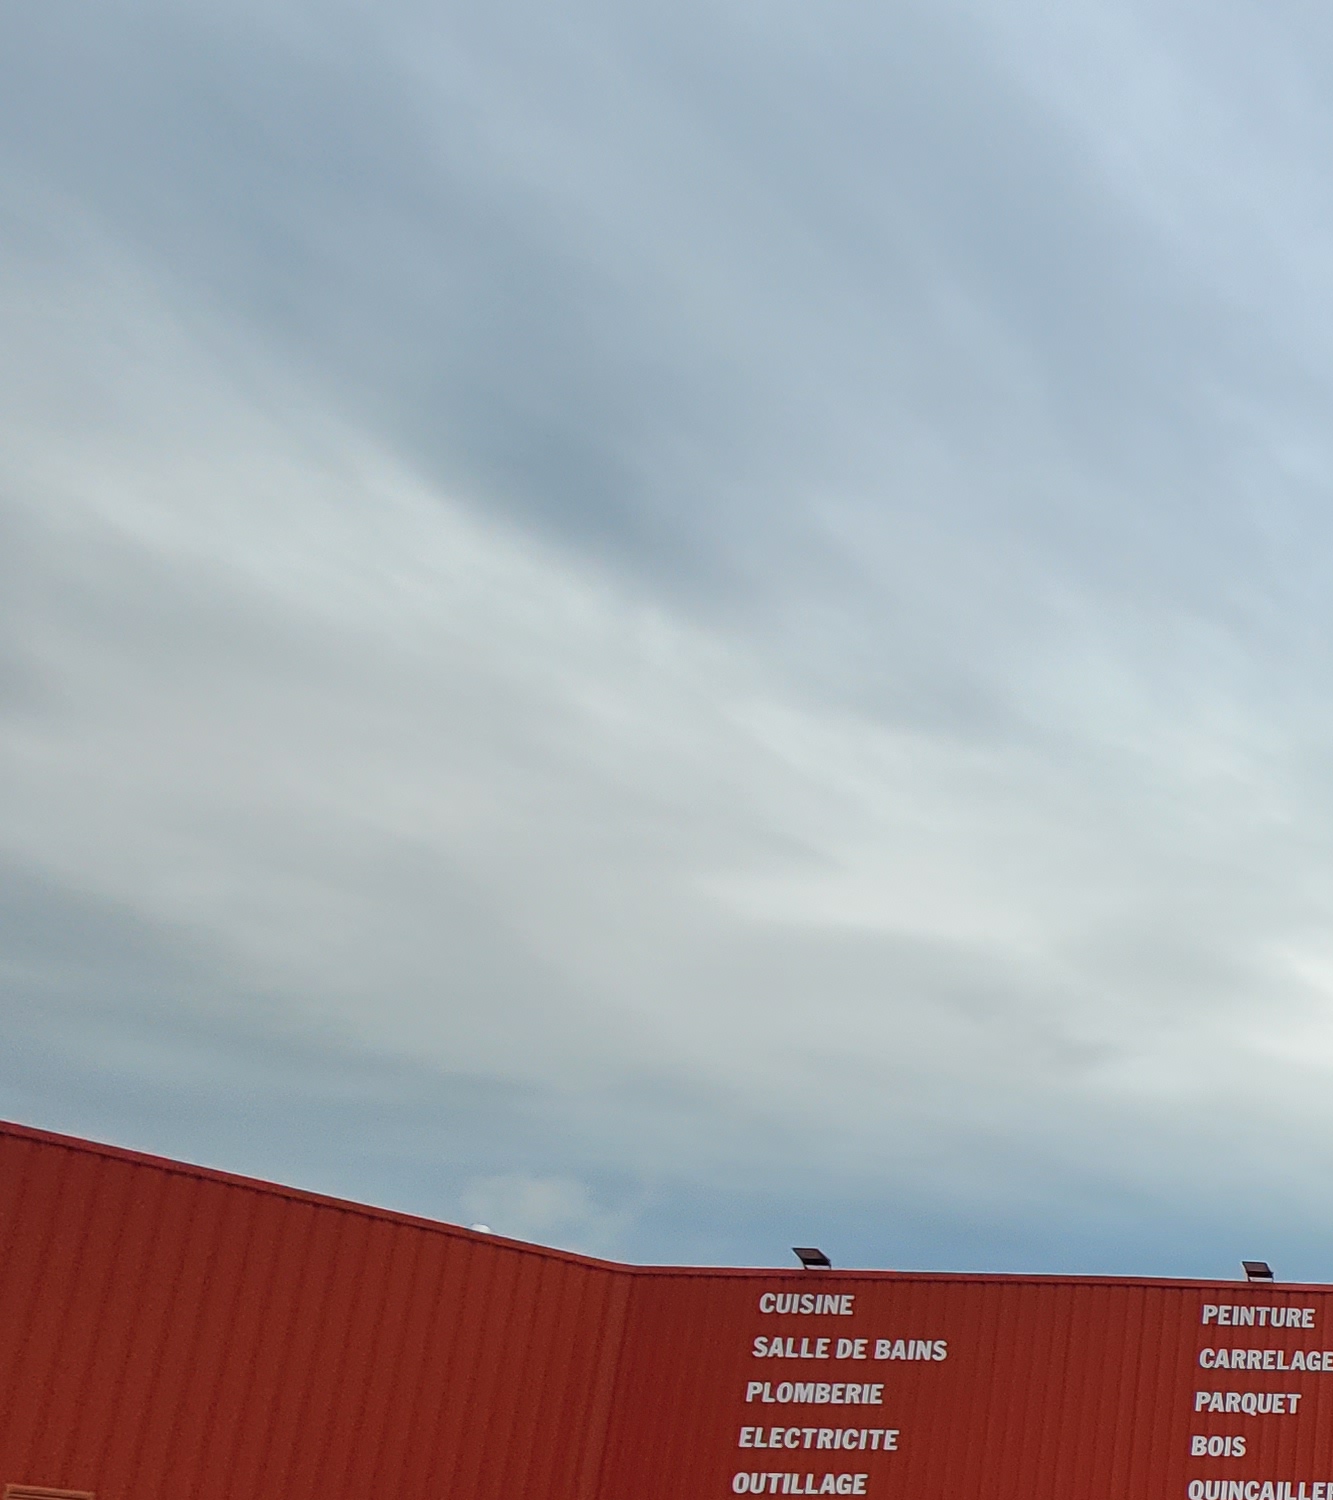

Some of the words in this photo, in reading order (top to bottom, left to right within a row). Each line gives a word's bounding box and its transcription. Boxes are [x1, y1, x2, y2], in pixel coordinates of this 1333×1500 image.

[759, 1292, 855, 1317] CUISINE
[1202, 1304, 1316, 1330] PEINTURE
[752, 1336, 831, 1361] SALLE
[837, 1338, 869, 1361] DE
[874, 1339, 948, 1363] BAINS
[746, 1381, 885, 1406] PLOMBERIE
[1195, 1391, 1302, 1418] PARQUET
[738, 1426, 900, 1452] ELECTRICITE
[1191, 1435, 1247, 1459] BOIS
[732, 1471, 869, 1497] OUTILLAGE
